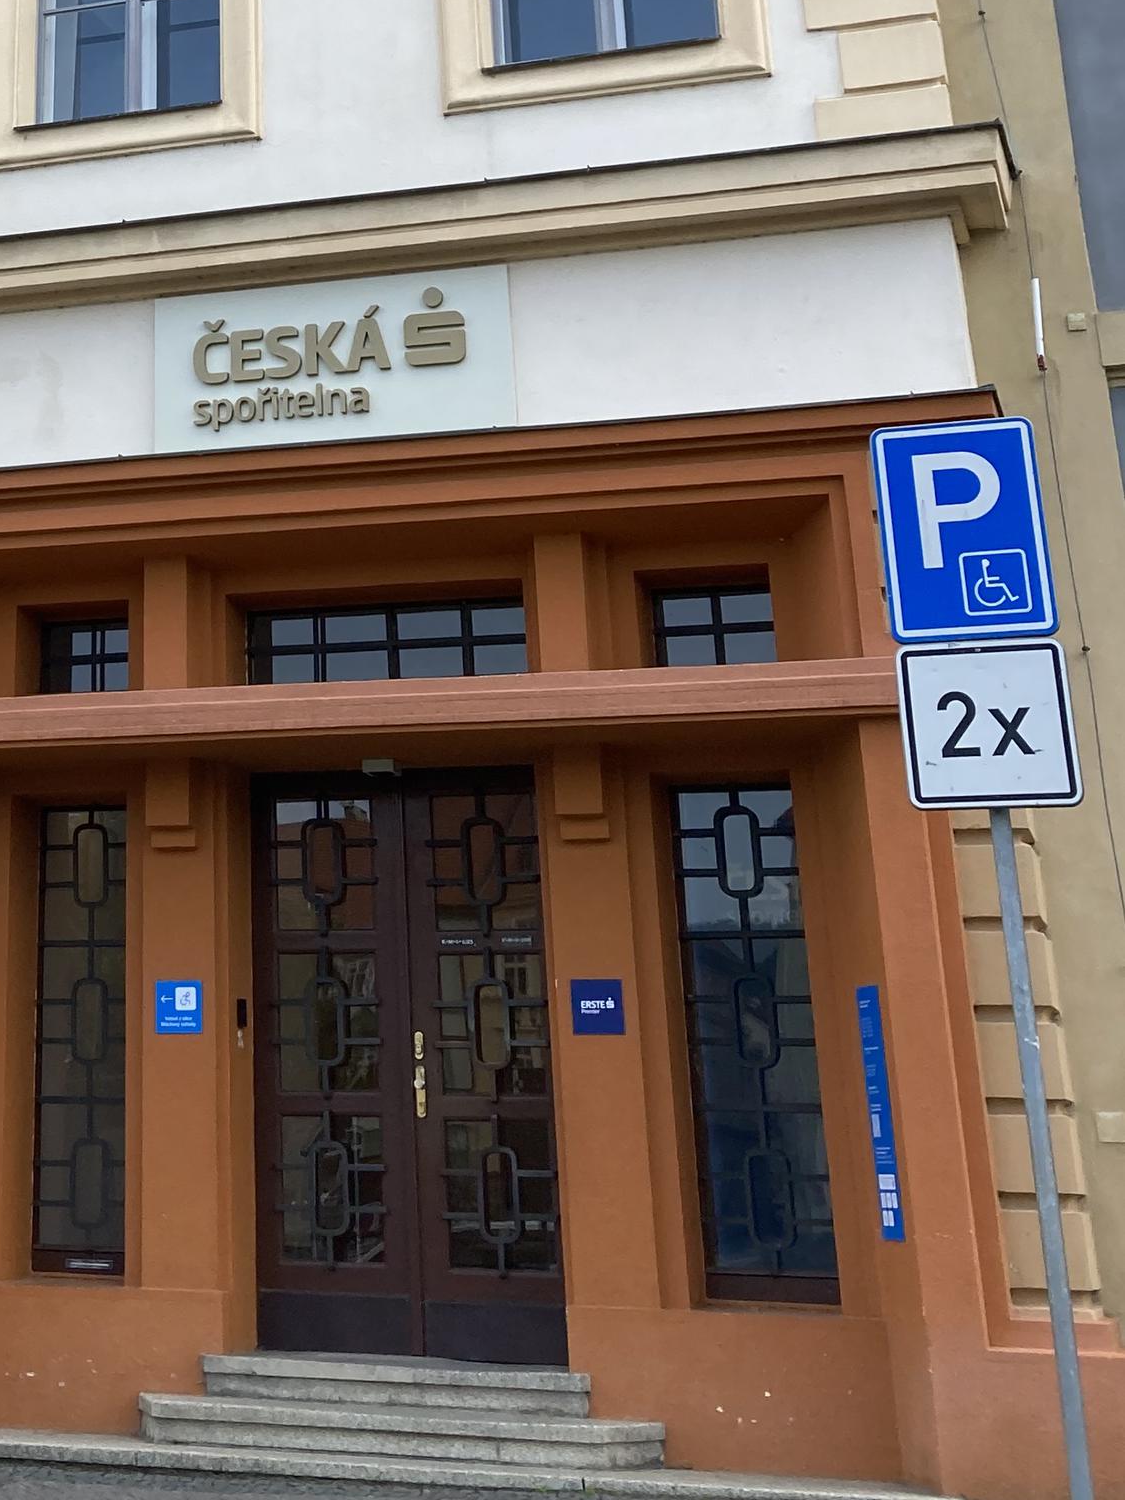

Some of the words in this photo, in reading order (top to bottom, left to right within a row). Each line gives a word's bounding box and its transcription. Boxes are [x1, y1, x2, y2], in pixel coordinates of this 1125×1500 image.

[193, 305, 391, 384] ČESKÁ
[193, 383, 370, 432] spořitelna
[911, 451, 1001, 569] P
[937, 691, 1035, 759] 2x
[581, 1000, 605, 1009] ERSTE
